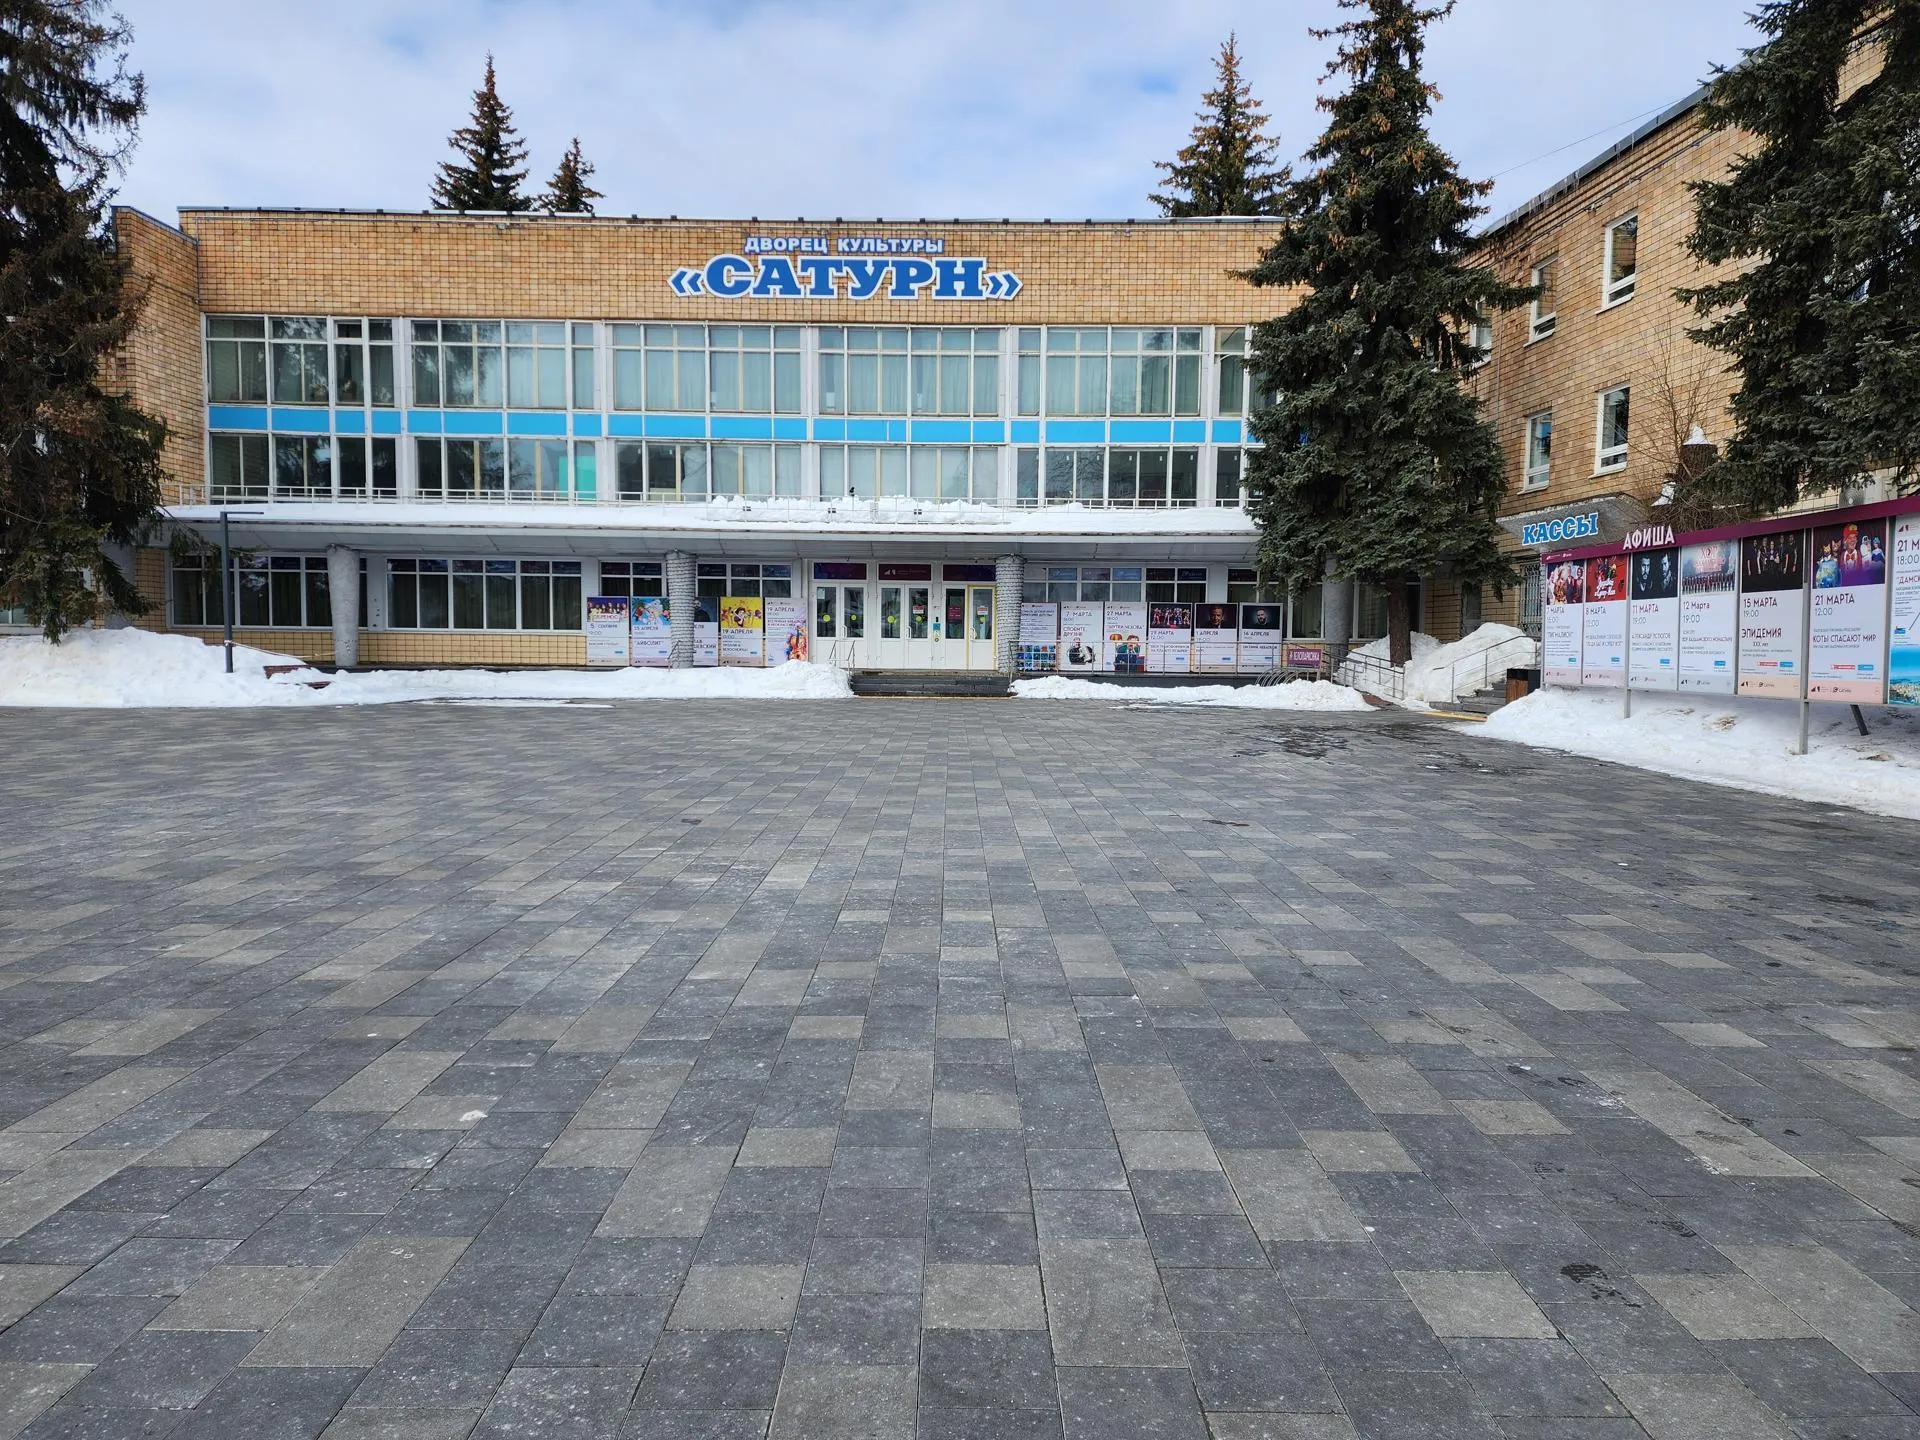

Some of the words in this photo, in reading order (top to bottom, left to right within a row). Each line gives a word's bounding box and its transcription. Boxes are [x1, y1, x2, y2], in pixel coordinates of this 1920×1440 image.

[744, 237, 828, 254] ДВОРЕЦ
[837, 237, 944, 253] КУЛЬТУРЫ
[666, 254, 1023, 300] «САТУРН»
[1522, 513, 1598, 545] КАССЫ
[1623, 525, 1675, 550] АФИША
[1897, 539, 1908, 552] 21
[1897, 554, 1920, 565] 18:00
[1744, 599, 1751, 608] 15
[1753, 597, 1778, 607] МАРТА
[1816, 595, 1823, 606] 21
[1826, 593, 1855, 605] МАРТА
[1551, 606, 1565, 614] МАРТА
[1590, 606, 1606, 615] МАРТА
[1639, 604, 1659, 613] МАРТА
[1683, 602, 1689, 610] 12
[1691, 601, 1710, 612] Марта
[1815, 608, 1833, 616] 12:00
[1683, 614, 1700, 624] 19:00
[1741, 628, 1782, 639] ЭПИДЕМИЯ
[1813, 635, 1829, 643] КОТЫ
[1830, 634, 1861, 643] СПАСАЮТ
